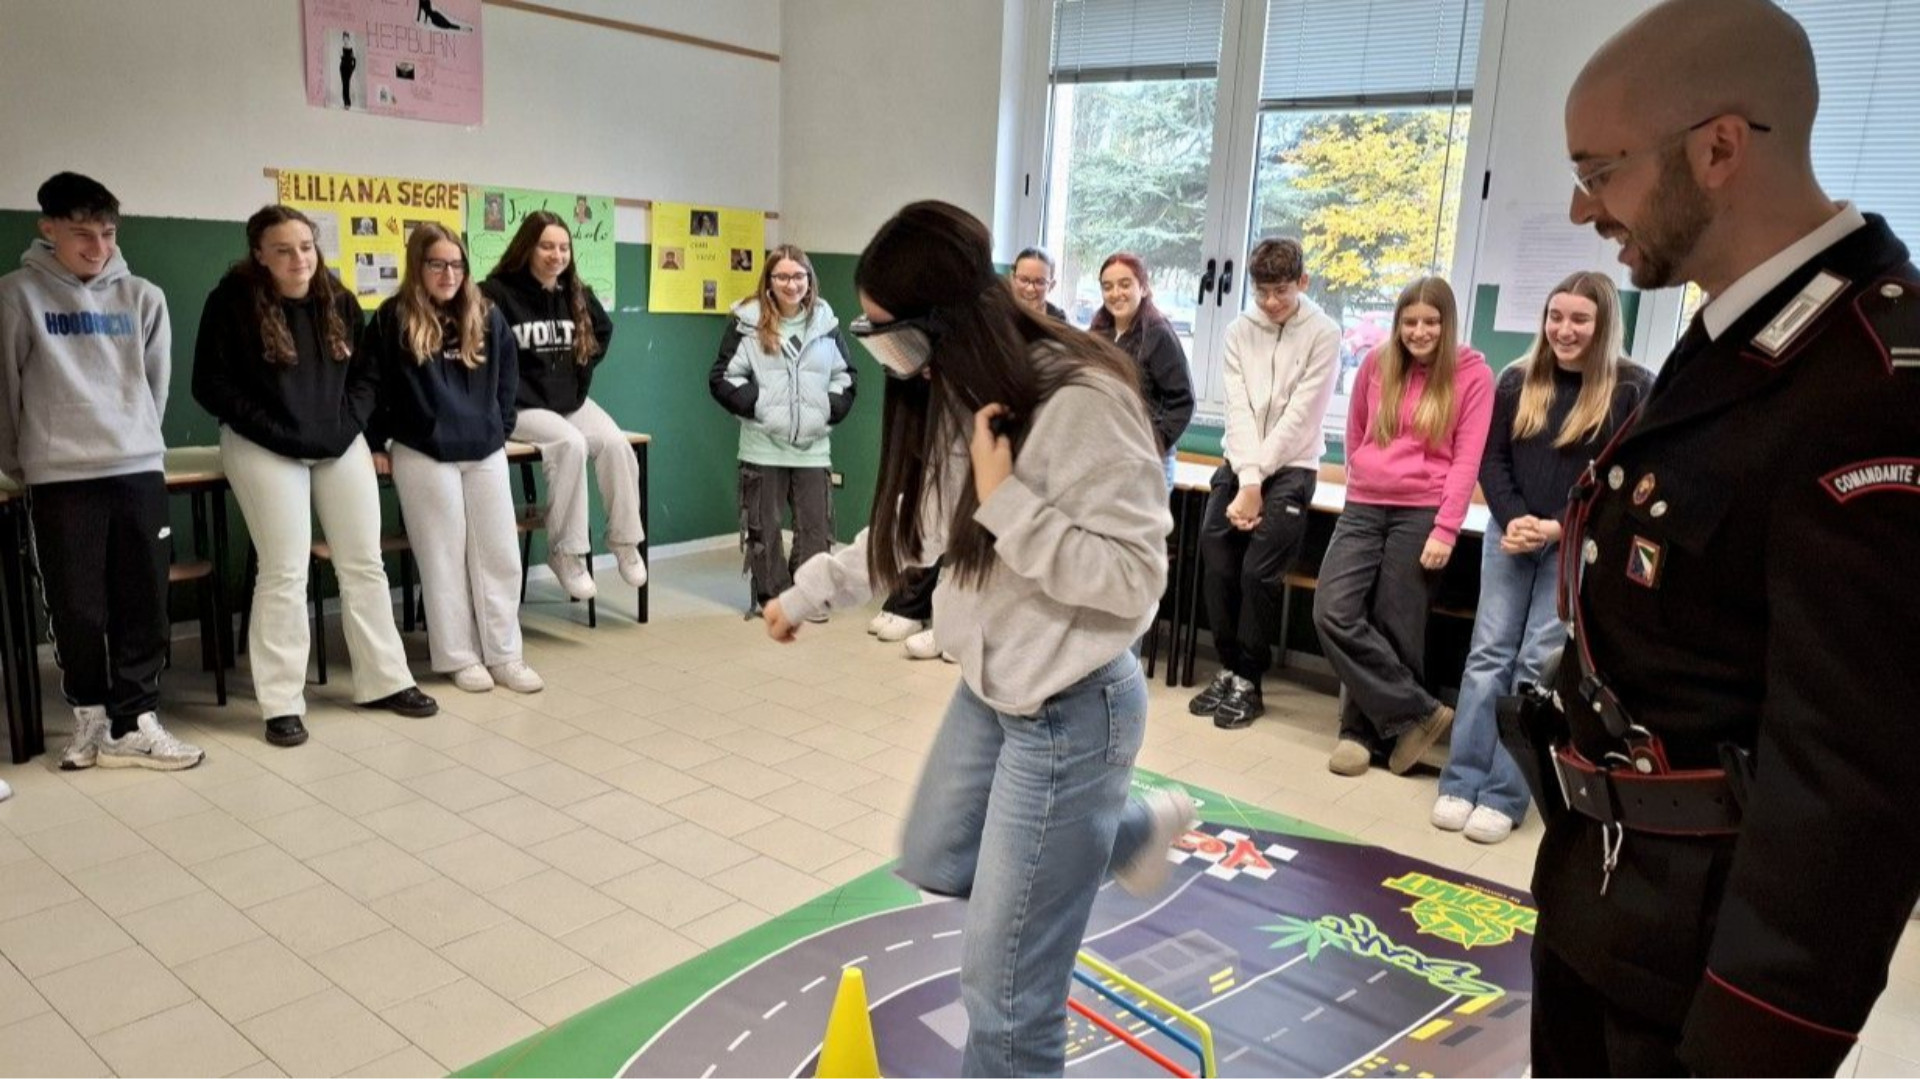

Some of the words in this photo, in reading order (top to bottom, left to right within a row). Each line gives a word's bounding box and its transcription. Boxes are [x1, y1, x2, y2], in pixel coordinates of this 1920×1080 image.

[365, 20, 457, 58] HEPBURN
[294, 173, 391, 204] LILIANA
[397, 181, 460, 210] SEGRE
[1834, 464, 1915, 493] COMANDANTE
